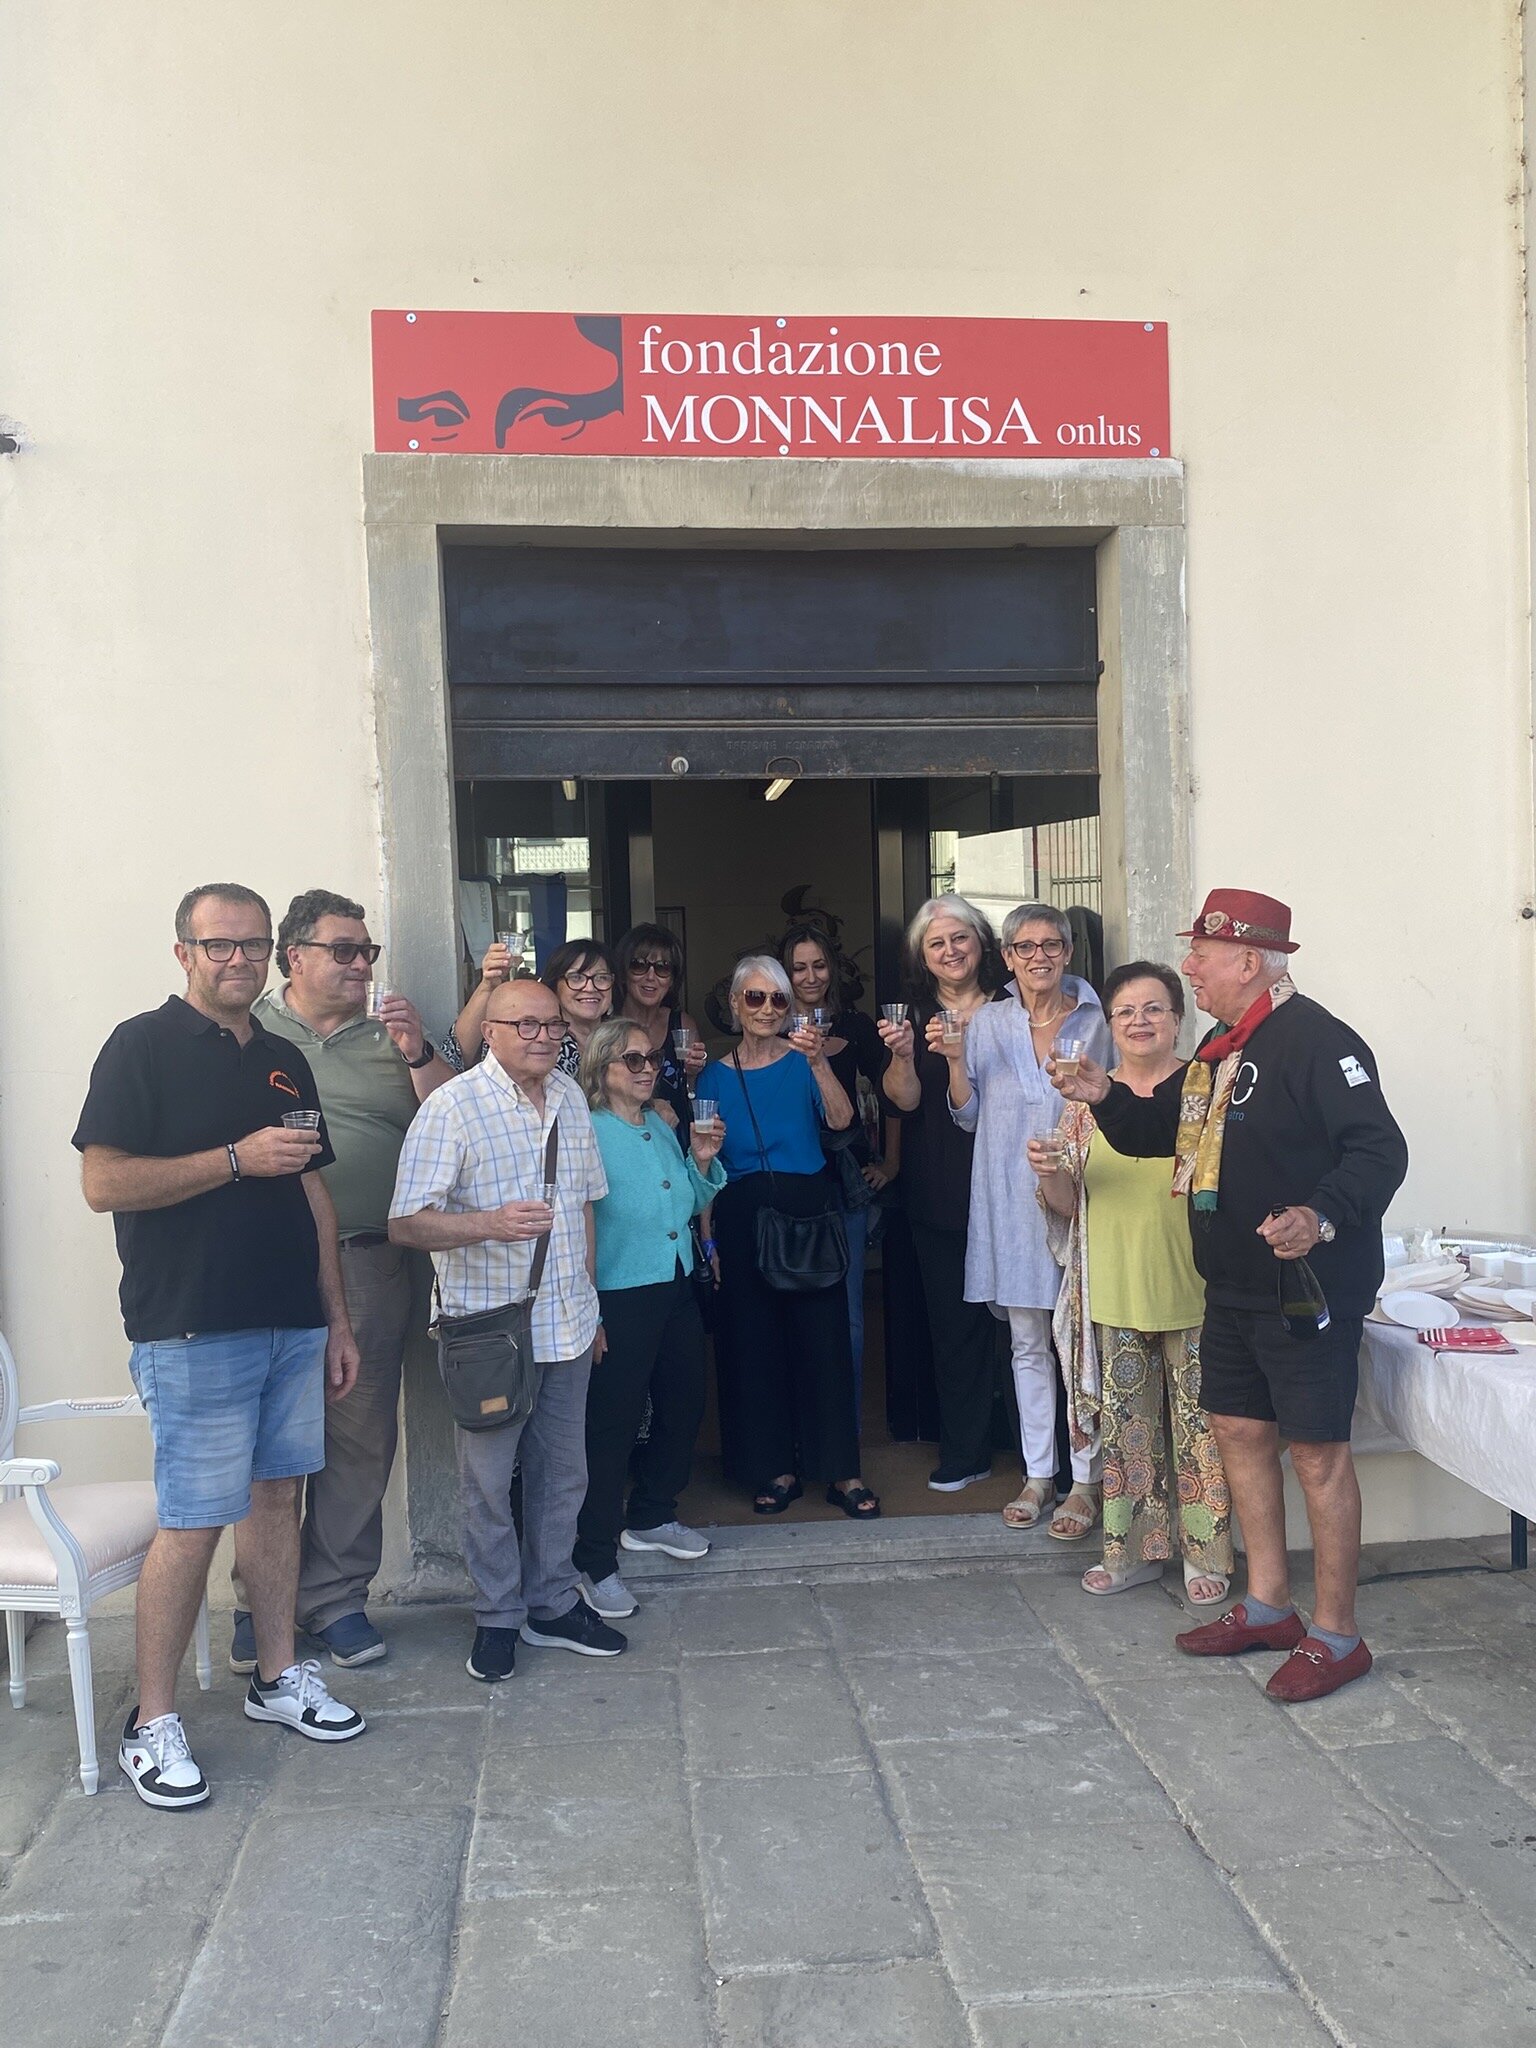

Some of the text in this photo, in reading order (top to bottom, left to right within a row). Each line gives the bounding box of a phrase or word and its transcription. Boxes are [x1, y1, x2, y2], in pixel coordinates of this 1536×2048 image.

[638, 325, 942, 377] fondazione
[641, 394, 1141, 447] MONNALISA onlus
